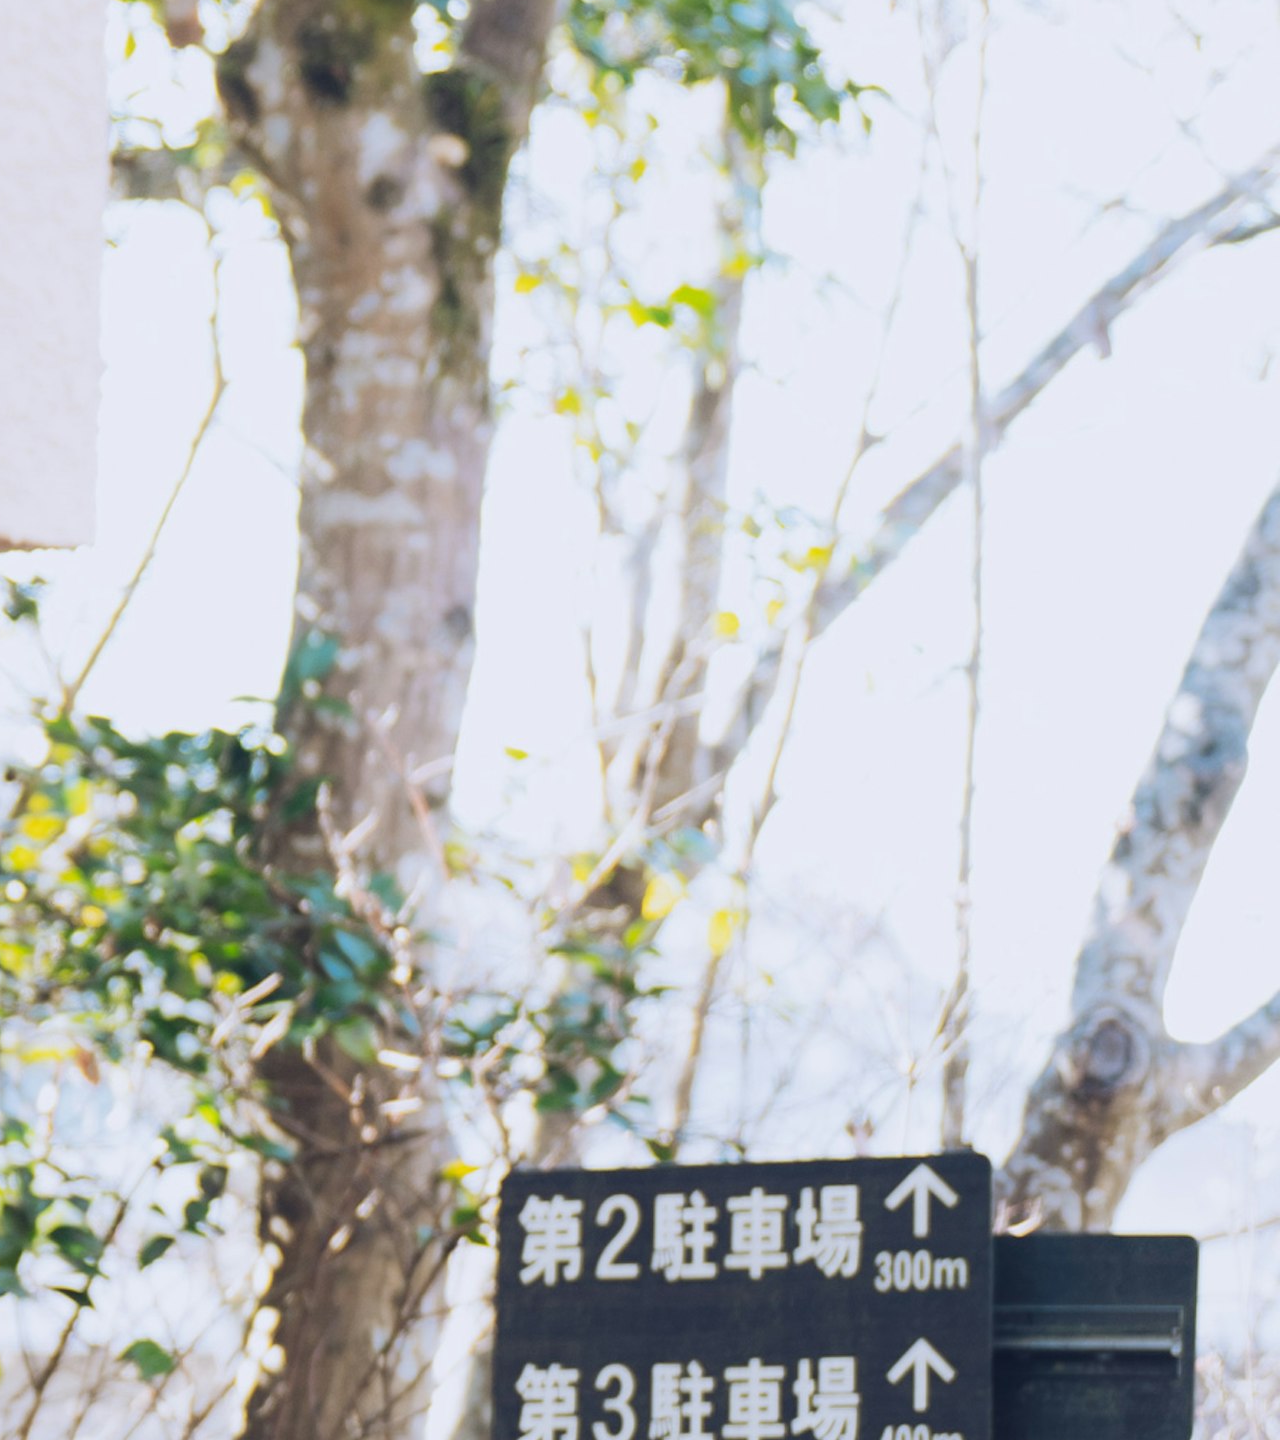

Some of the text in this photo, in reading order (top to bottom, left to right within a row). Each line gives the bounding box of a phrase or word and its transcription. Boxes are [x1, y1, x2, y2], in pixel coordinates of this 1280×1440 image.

[518, 1184, 969, 1293] 第2駐車場 300m
